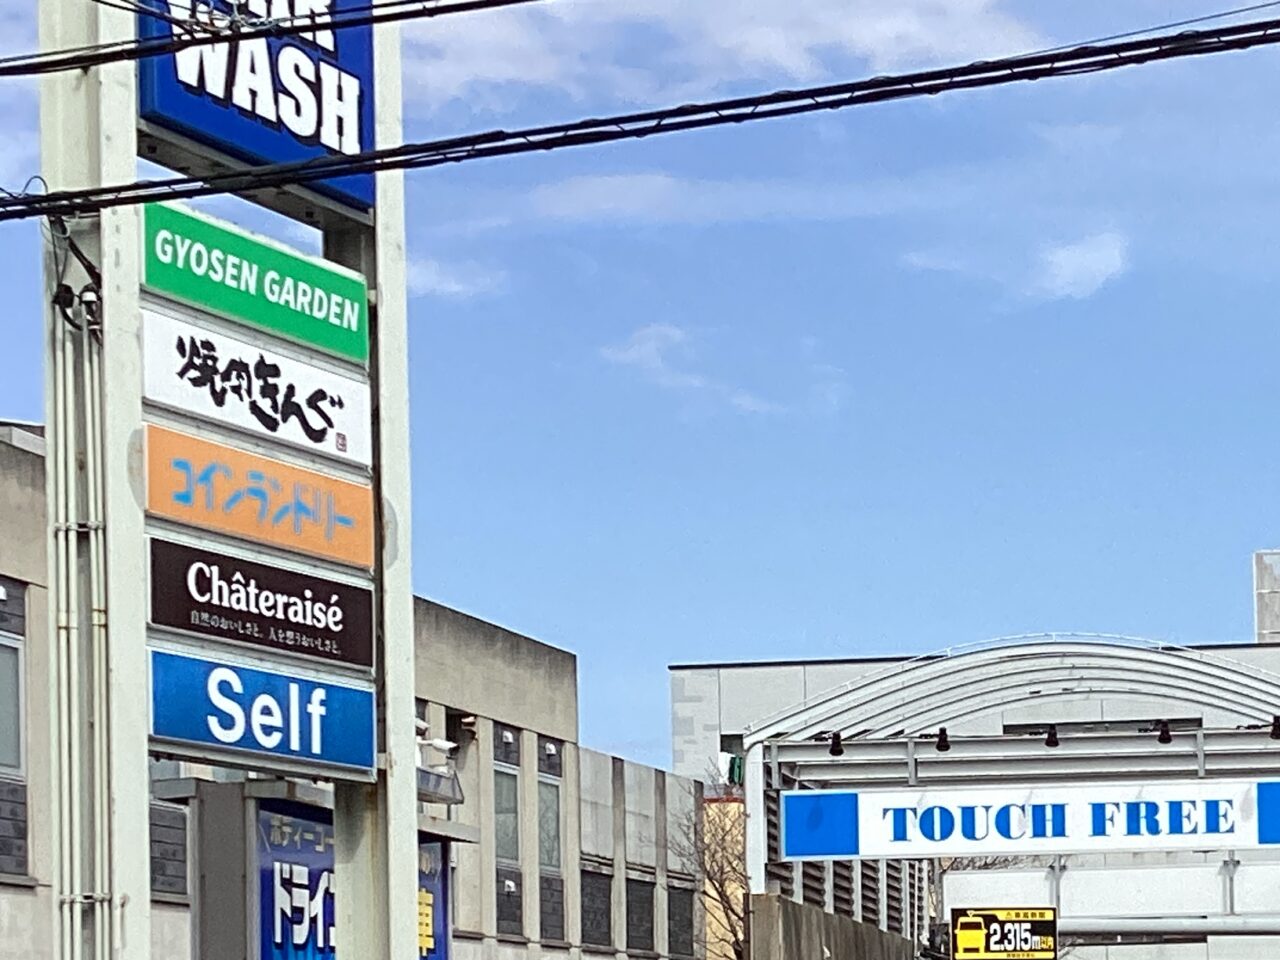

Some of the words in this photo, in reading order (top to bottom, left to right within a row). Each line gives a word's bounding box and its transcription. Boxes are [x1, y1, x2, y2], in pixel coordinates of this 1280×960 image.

[173, 37, 361, 156] WASH
[155, 229, 259, 295] GYOSEN
[263, 270, 360, 332] GARDEN
[176, 335, 346, 443] 焼肉きんぐ
[170, 457, 356, 542] コインランドリー
[187, 561, 343, 632] Châteraisé
[207, 667, 327, 754] Self
[883, 802, 1068, 842] TOUCH
[1088, 799, 1236, 837] FREE
